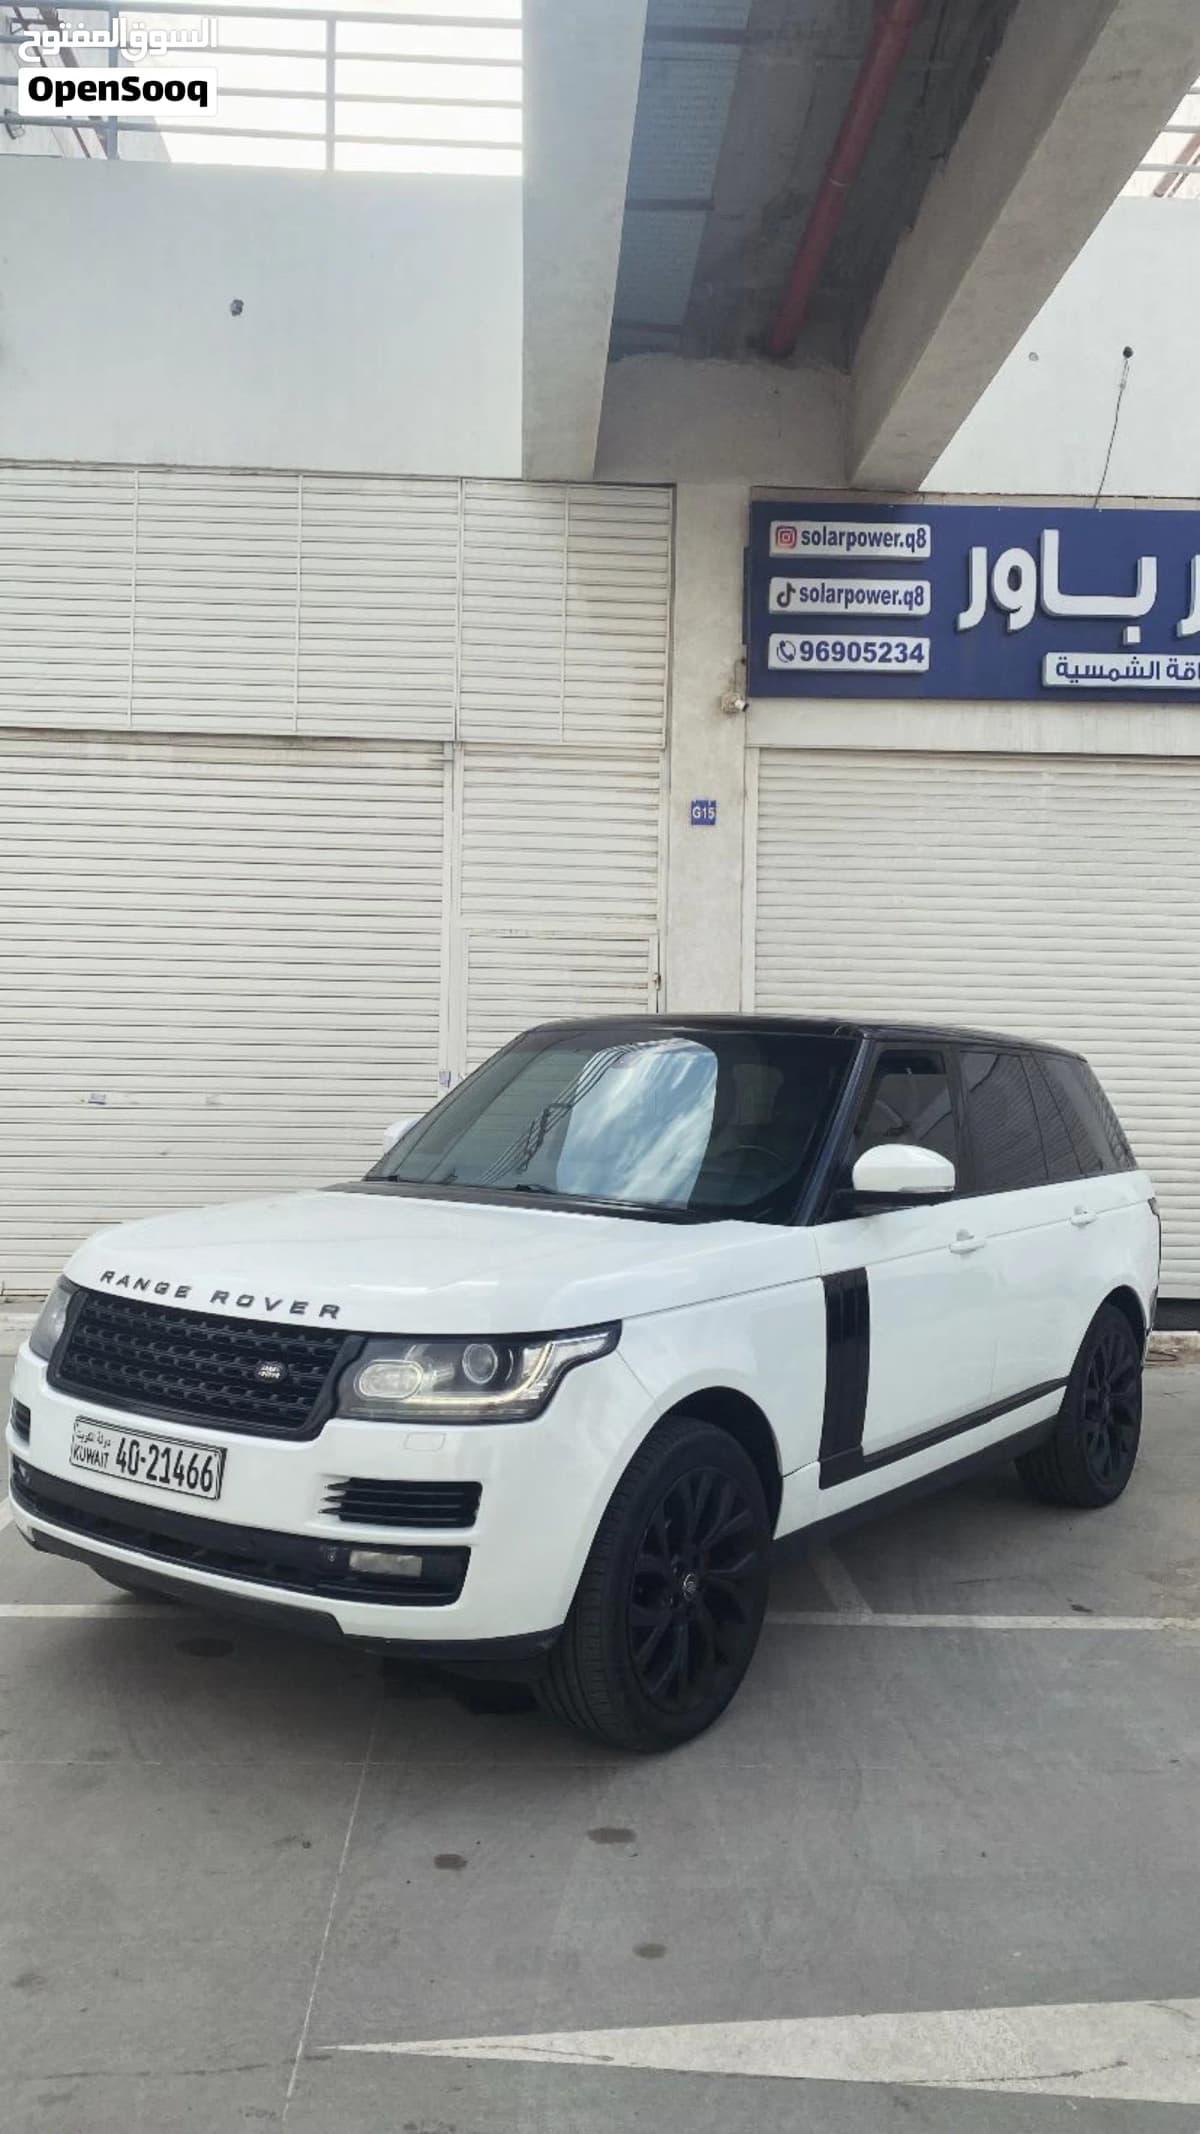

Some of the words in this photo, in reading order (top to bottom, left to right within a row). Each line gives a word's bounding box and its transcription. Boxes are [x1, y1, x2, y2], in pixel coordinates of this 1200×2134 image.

[800, 526, 927, 553] solarpower.q8
[799, 582, 924, 611] solarpower.q8
[957, 529, 1157, 645] باور
[800, 640, 925, 663] 96905234
[1056, 656, 1160, 683] الشمسية
[692, 806, 716, 820] G15
[100, 1270, 192, 1299] RANGE
[210, 1290, 340, 1319] ROVER
[73, 1445, 109, 1468] KUWAIT
[116, 1437, 213, 1492] 40-21466
